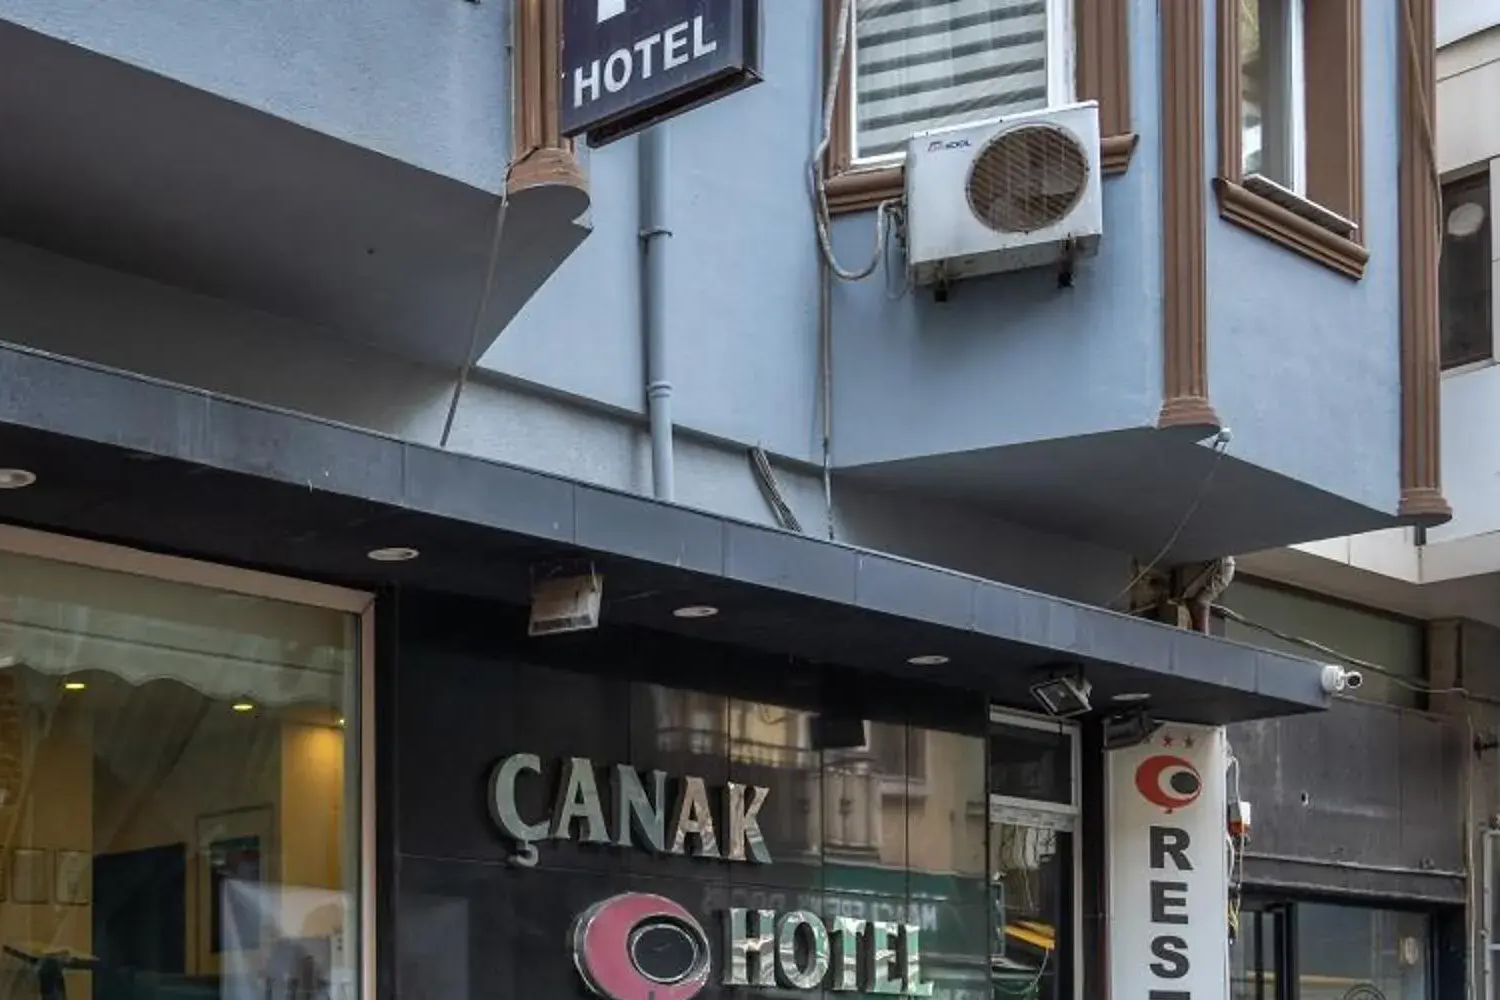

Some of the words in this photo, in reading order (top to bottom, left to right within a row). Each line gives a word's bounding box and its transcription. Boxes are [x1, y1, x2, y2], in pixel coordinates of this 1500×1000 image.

[573, 15, 717, 108] HOTEL
[489, 752, 773, 867] ÇANAK
[723, 907, 935, 996] HOTEL
